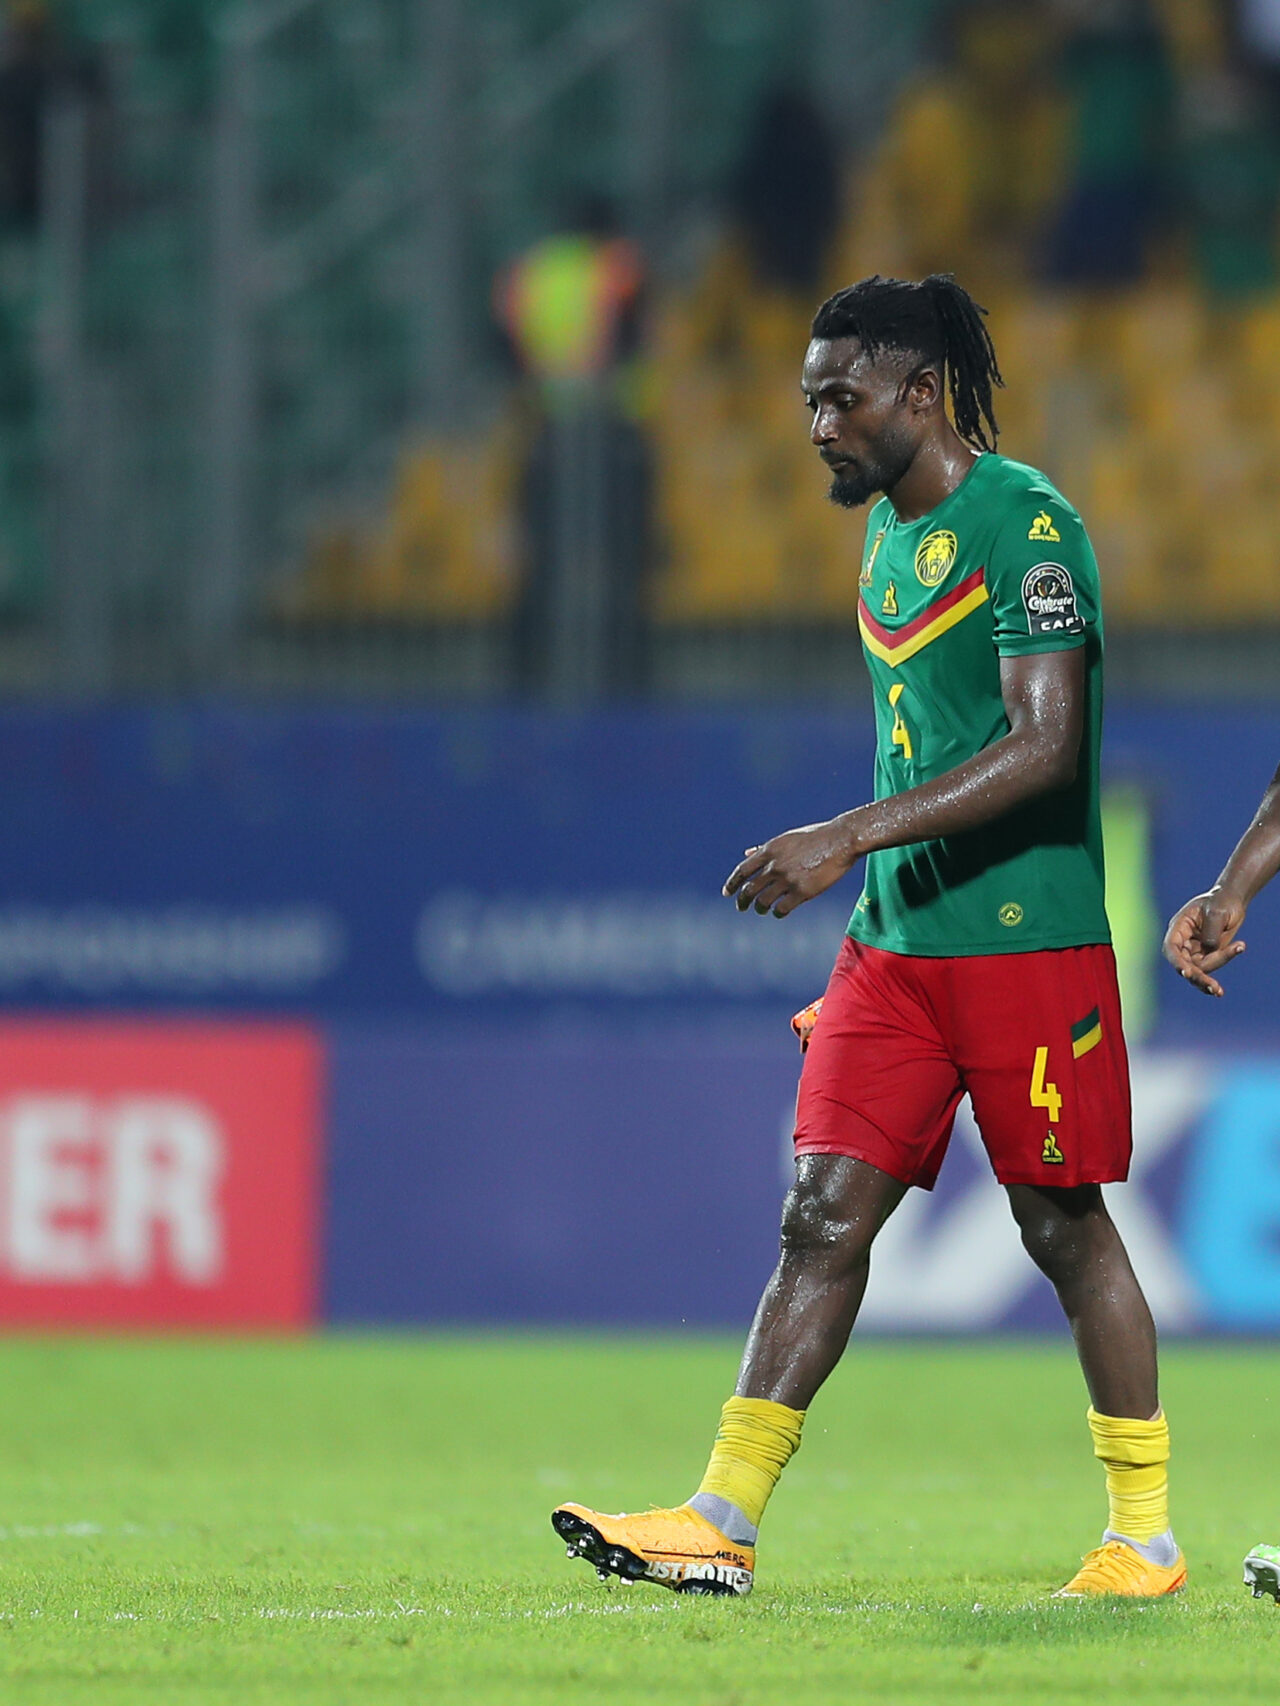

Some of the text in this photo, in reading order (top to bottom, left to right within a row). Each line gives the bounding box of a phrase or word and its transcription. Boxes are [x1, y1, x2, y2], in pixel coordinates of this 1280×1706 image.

[1041, 617, 1075, 631] CAF
[888, 683, 911, 759] 4
[1030, 1046, 1062, 1123] 4
[3, 1090, 226, 1288] ER
